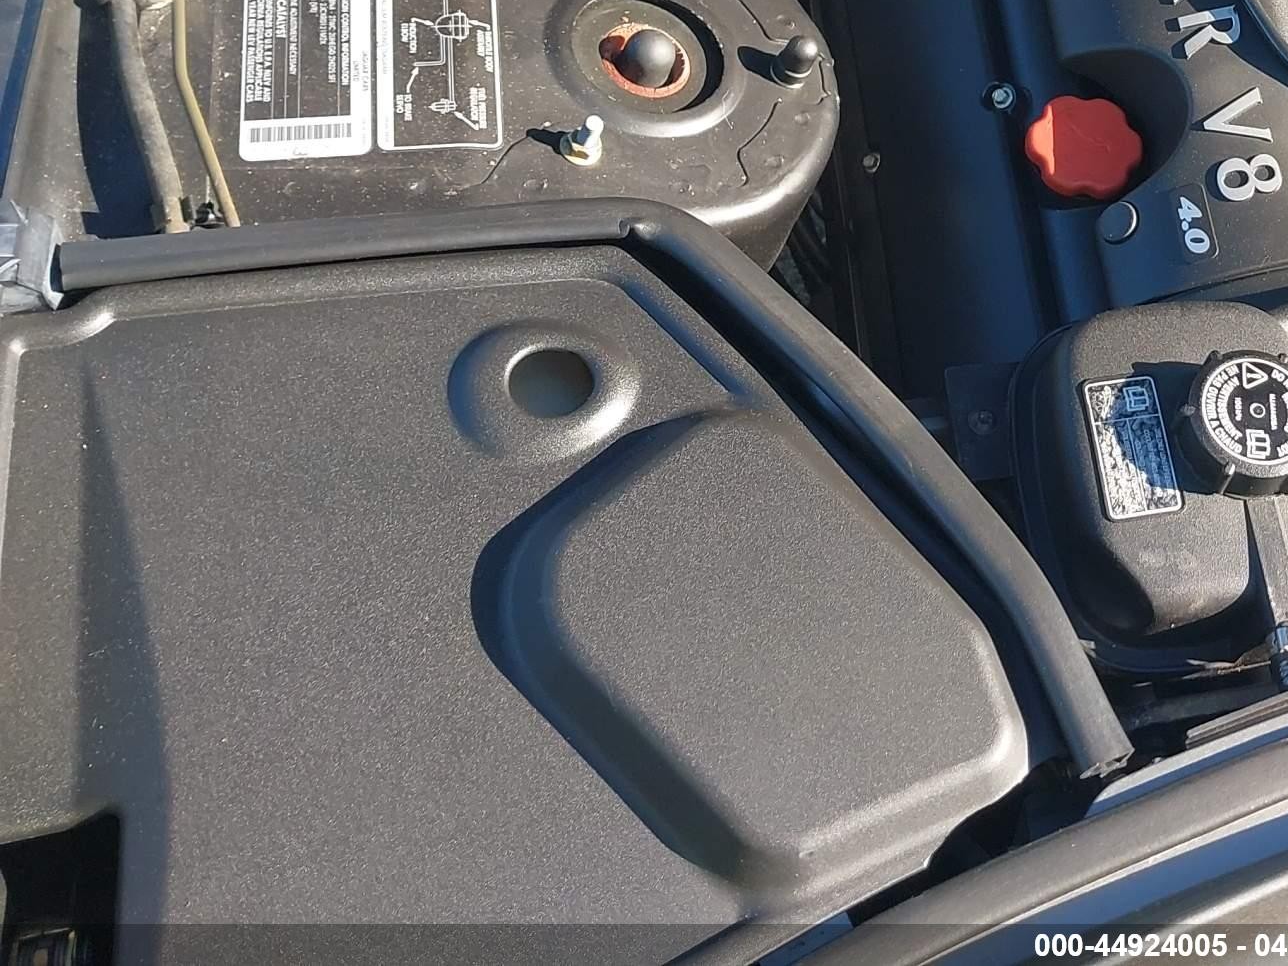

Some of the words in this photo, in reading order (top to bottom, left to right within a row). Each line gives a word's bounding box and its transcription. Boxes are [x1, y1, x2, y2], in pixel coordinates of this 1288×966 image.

[248, 1, 256, 18] YEAR
[275, 0, 287, 38] CATALYST
[265, 28, 272, 38] TO
[290, 8, 298, 42] ADJUSTMENT
[341, 13, 350, 41] CONTROL
[408, 23, 416, 53] INDUCTION
[247, 34, 255, 46] LEV
[256, 20, 264, 63] REGULATIONS
[246, 47, 255, 82] PASSENGER
[289, 43, 297, 75] NECESSARY
[341, 42, 350, 85] INFORMATION
[485, 56, 493, 72] BODY
[246, 83, 254, 102] CARS
[255, 64, 263, 101] APPLICABLE
[263, 87, 271, 102] AND
[396, 94, 404, 114] SERVO
[405, 94, 412, 102] TO
[404, 103, 412, 121] BRAKE
[1202, 87, 1283, 202] V8
[1177, 195, 1210, 254] 4.0
[1212, 371, 1228, 387] PAS
[1225, 364, 1240, 376] NE
[1271, 369, 1285, 382] DO
[1206, 387, 1219, 420] OUVRIR
[1217, 376, 1243, 440] AVERTISSEMENT
[1214, 427, 1243, 454] CHAUD
